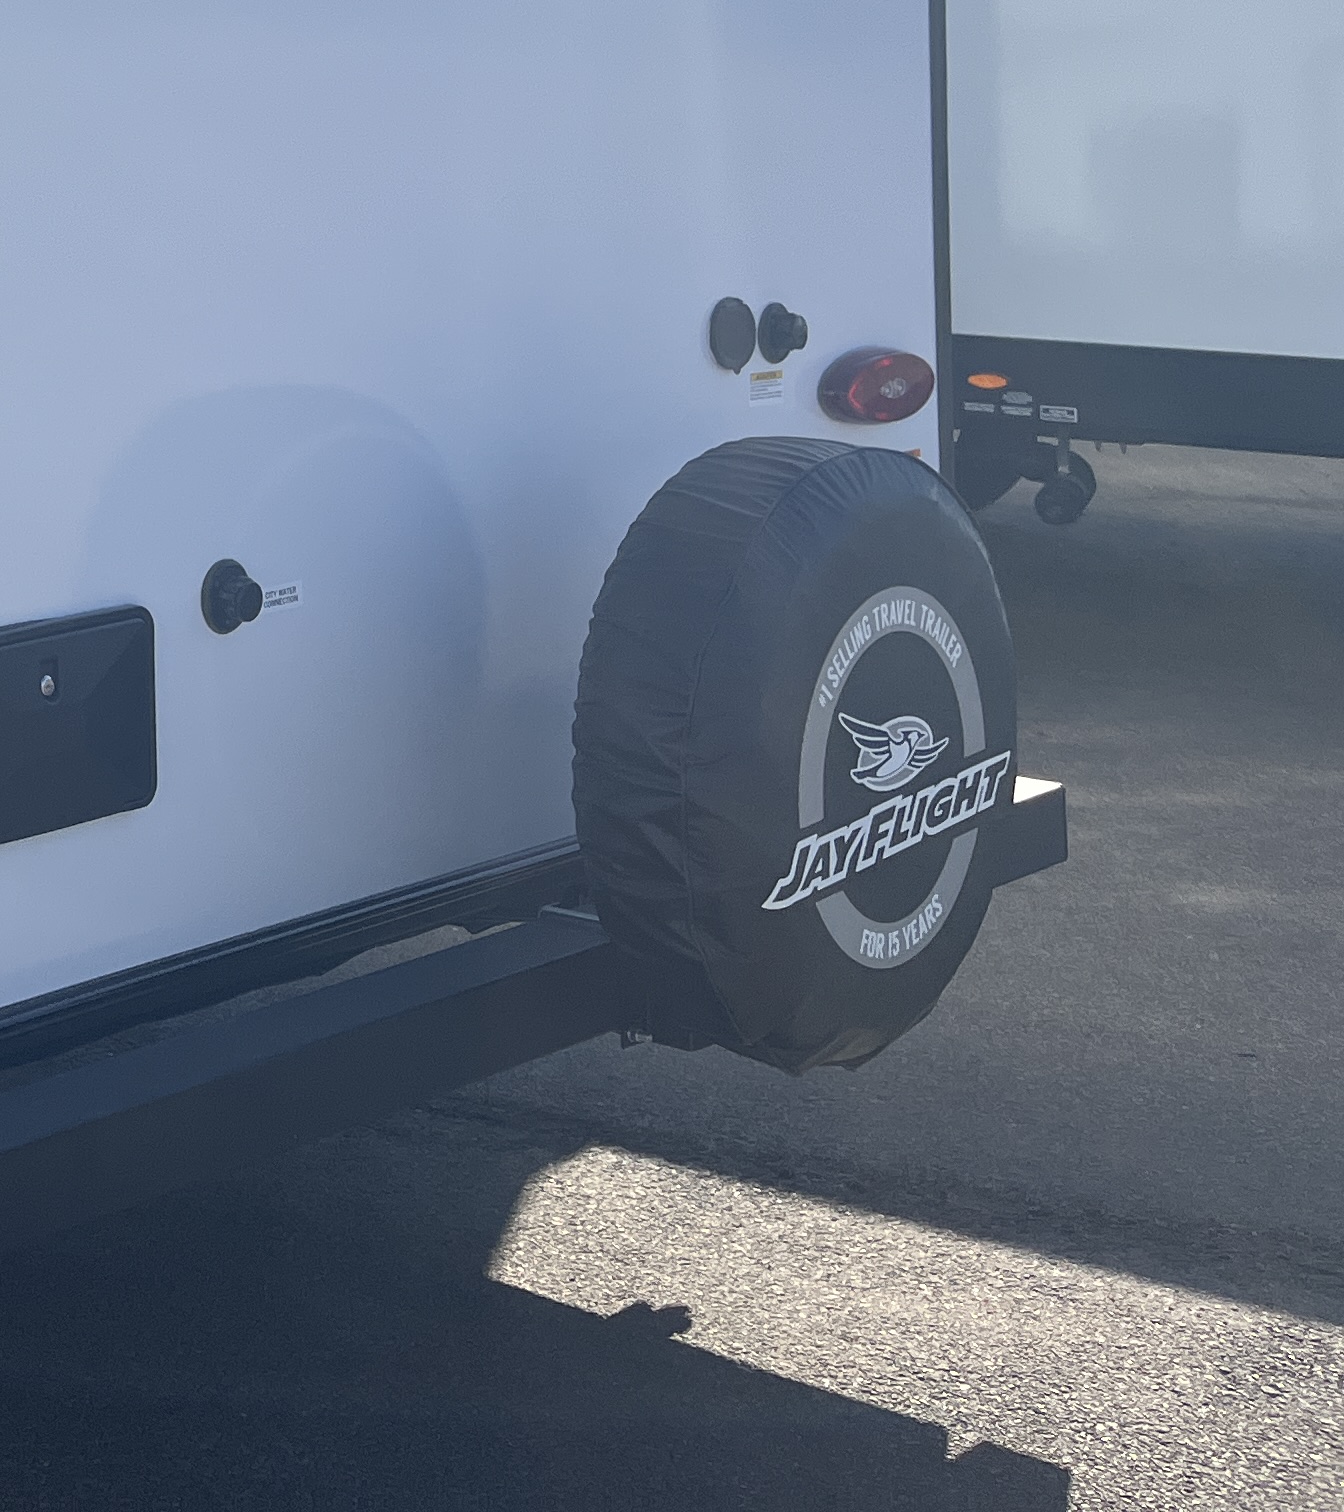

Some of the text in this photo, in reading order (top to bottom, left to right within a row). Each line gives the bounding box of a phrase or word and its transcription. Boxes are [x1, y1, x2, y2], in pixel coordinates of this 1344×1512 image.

[818, 599, 963, 708] #1 SELLING TRAVEL TRAILER
[859, 893, 943, 959] FOR 15 YEARS
